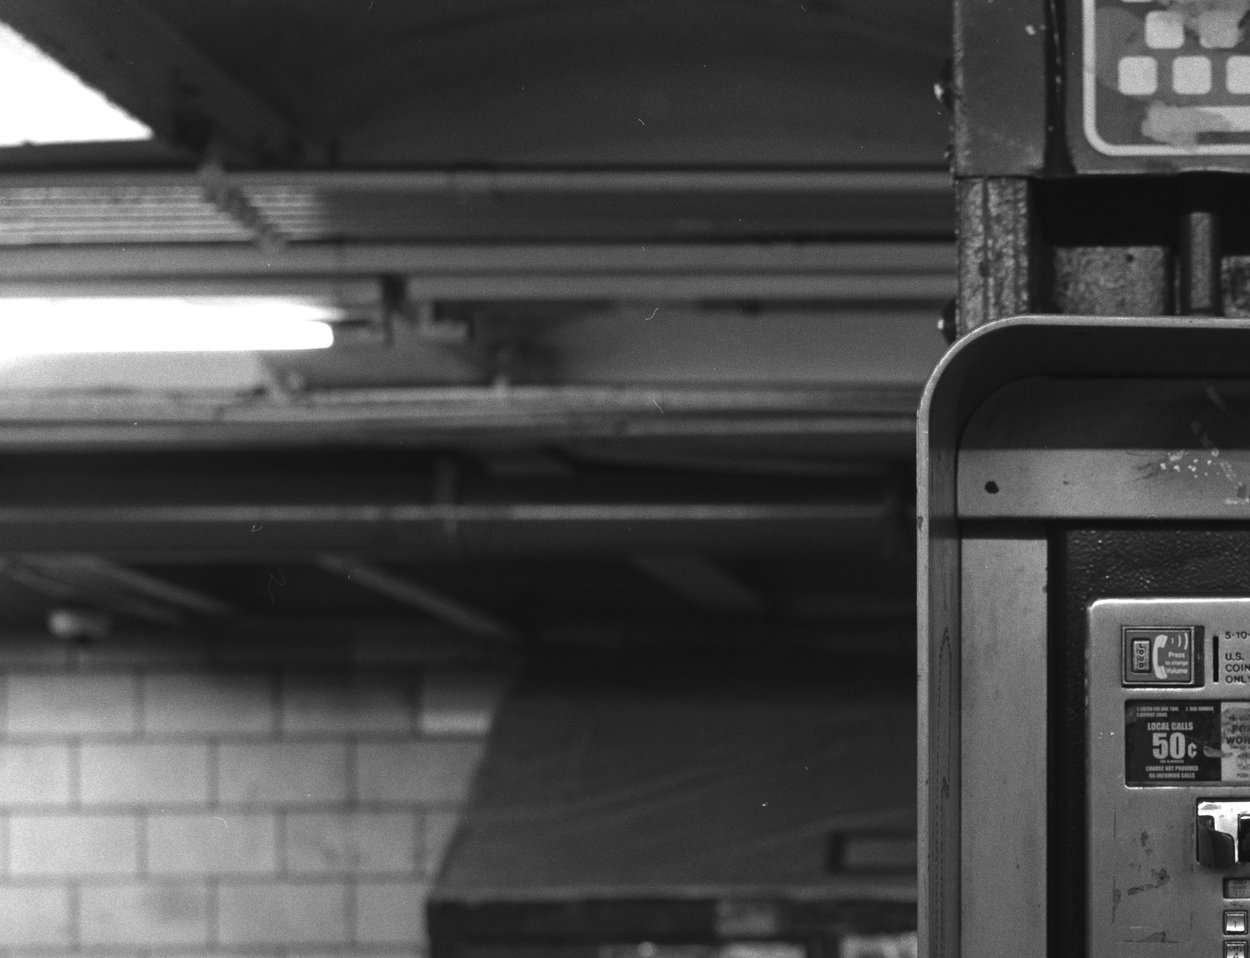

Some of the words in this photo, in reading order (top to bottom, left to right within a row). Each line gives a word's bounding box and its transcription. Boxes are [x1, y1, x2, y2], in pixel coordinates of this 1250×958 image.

[1225, 652, 1245, 661] U.S.
[1147, 722, 1170, 731] LOCAL
[1171, 722, 1194, 731] CALLS
